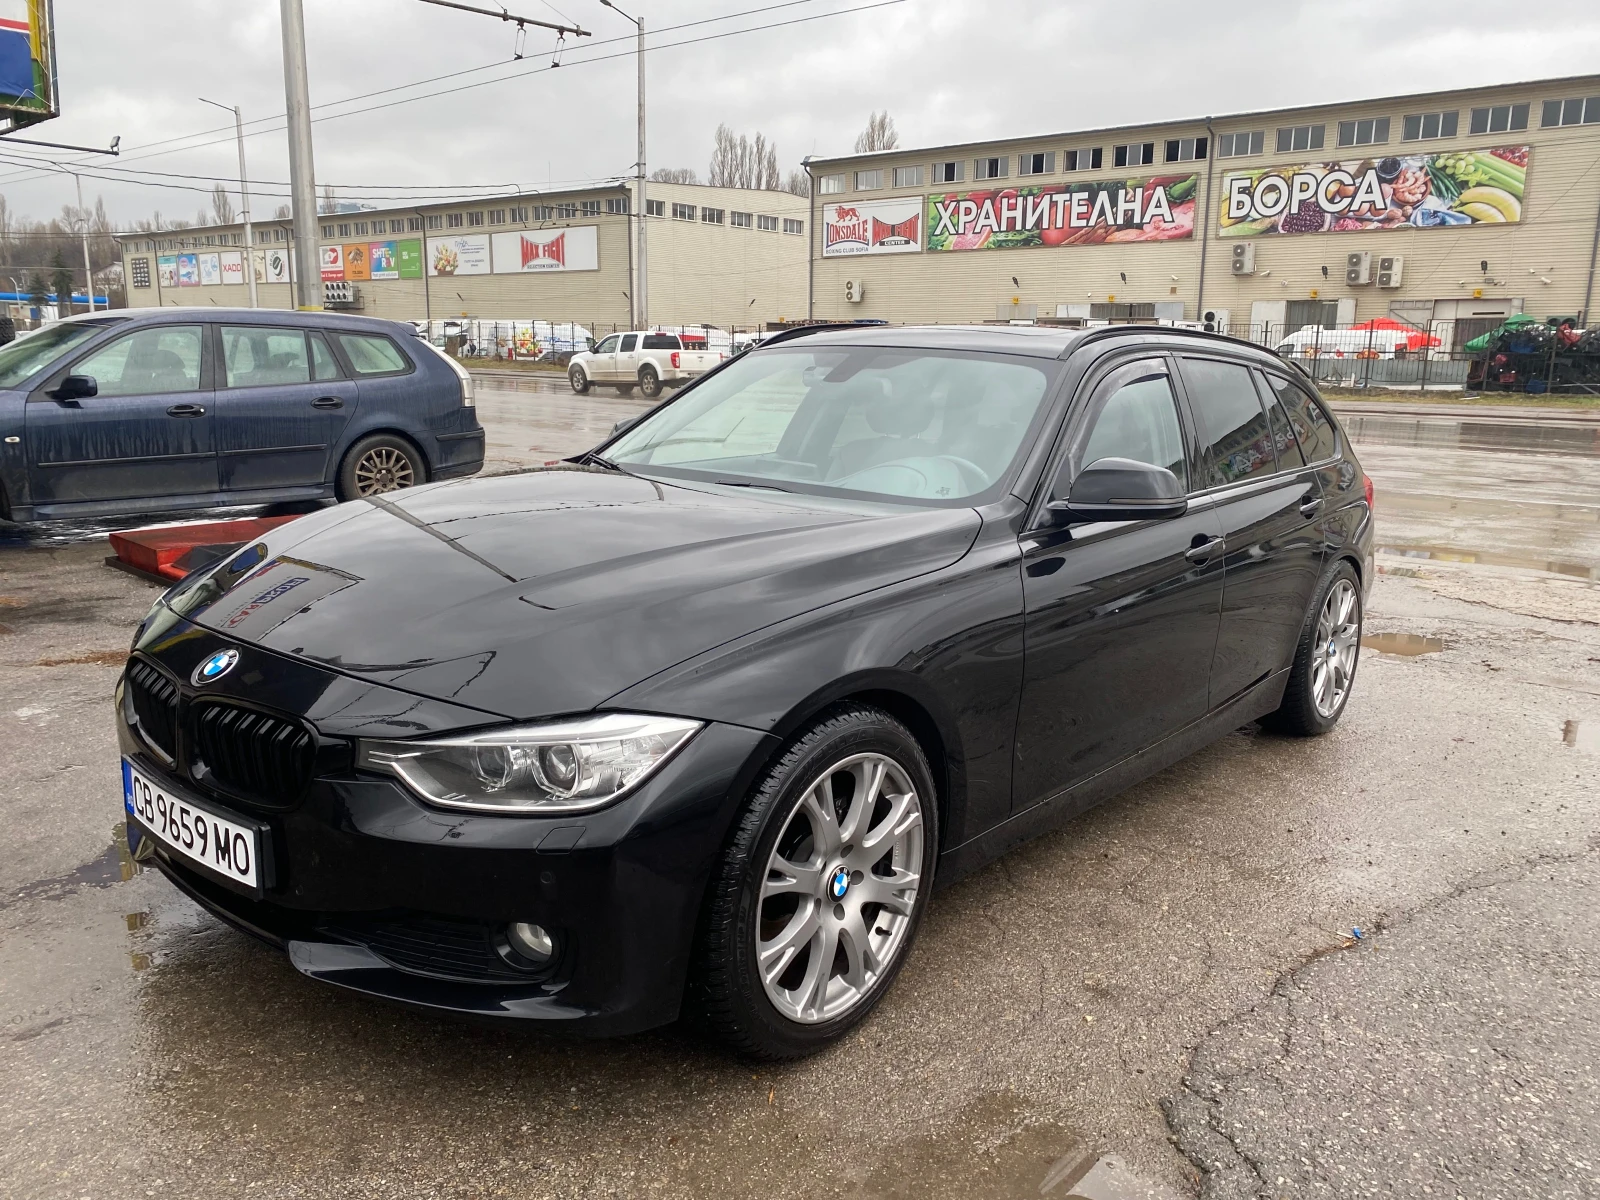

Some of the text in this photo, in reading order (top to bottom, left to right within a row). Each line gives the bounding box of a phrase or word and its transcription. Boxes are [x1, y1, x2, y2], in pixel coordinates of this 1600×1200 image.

[933, 185, 1175, 236] ХРАНИТЕЛНА
[1228, 168, 1387, 219] БОРСА
[826, 219, 869, 248] LONSDALE
[872, 212, 919, 247] MAX FIGHT
[134, 775, 250, 876] CB 9659 MO
